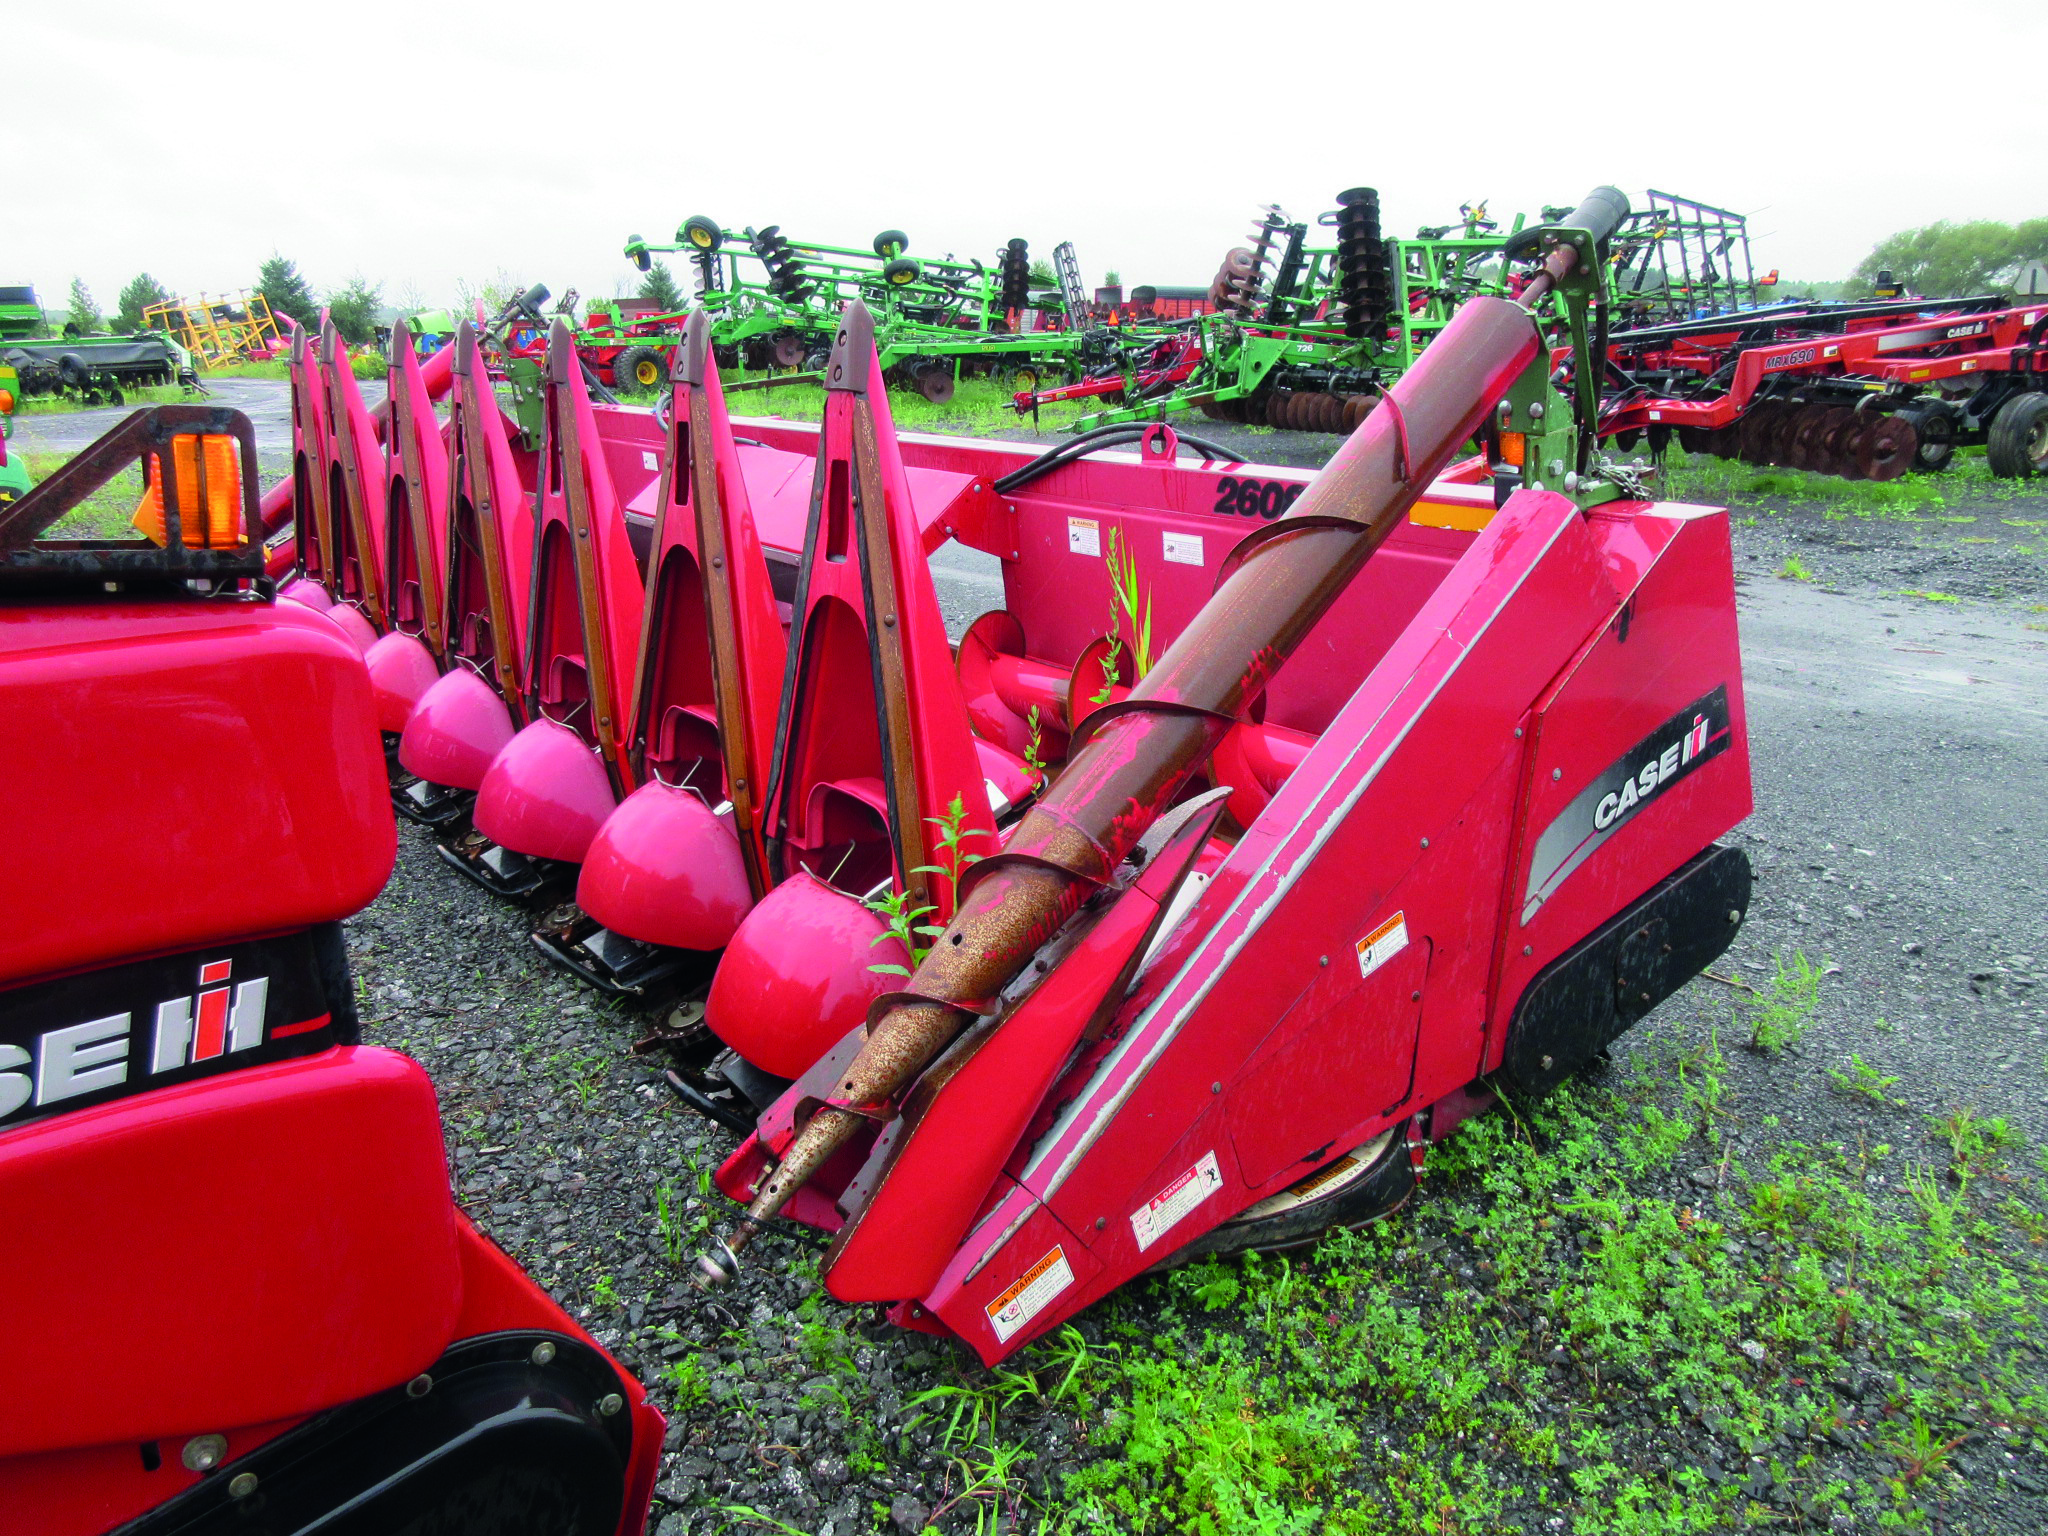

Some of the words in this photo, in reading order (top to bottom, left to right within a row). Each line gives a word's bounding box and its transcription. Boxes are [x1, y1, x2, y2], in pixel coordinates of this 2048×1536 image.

[1947, 326, 1973, 338] CASE
[1766, 348, 1815, 369] MRX690
[1595, 741, 1680, 829] CASE
[1371, 918, 1400, 941] WARNING
[1162, 1172, 1192, 1199] DANGER
[1308, 1160, 1353, 1187] WARNING
[1010, 1258, 1052, 1295] WARNING
